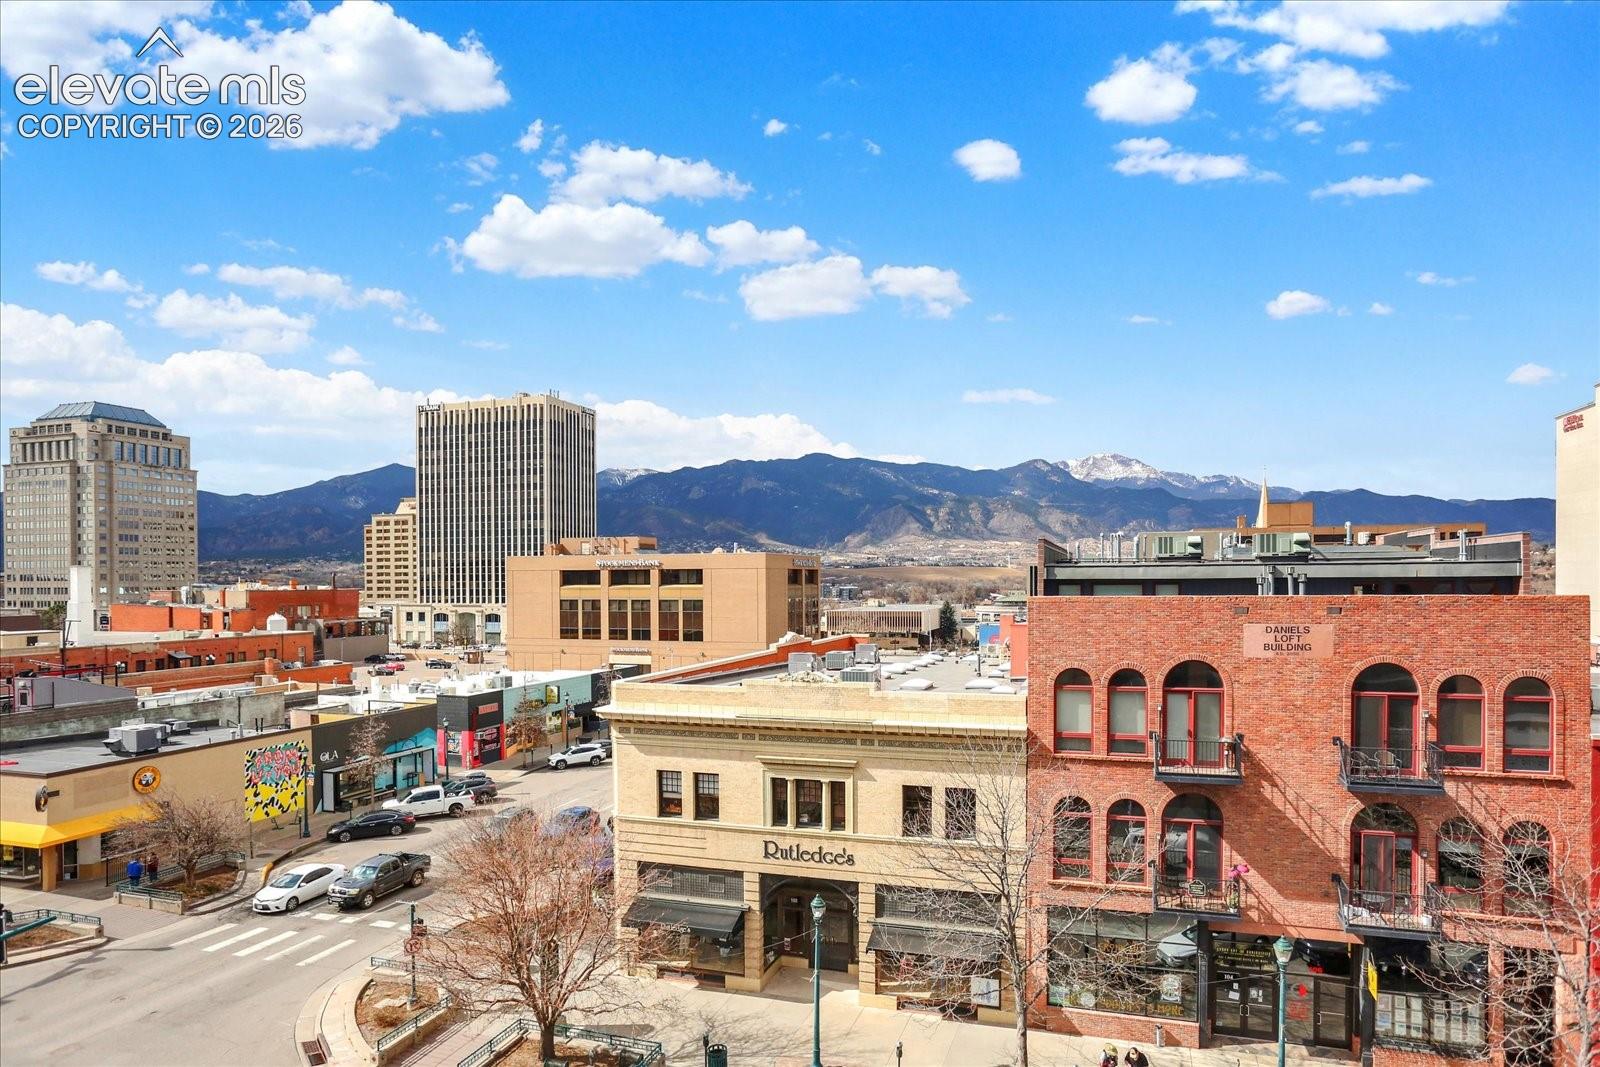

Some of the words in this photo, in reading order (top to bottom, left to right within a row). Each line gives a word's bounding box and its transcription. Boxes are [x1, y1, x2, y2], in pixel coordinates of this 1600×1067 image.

[1265, 626, 1311, 634] DANIELS
[1274, 634, 1303, 643] LOFT
[1263, 643, 1312, 651] BUILDING
[763, 840, 855, 866] Rutledge's
